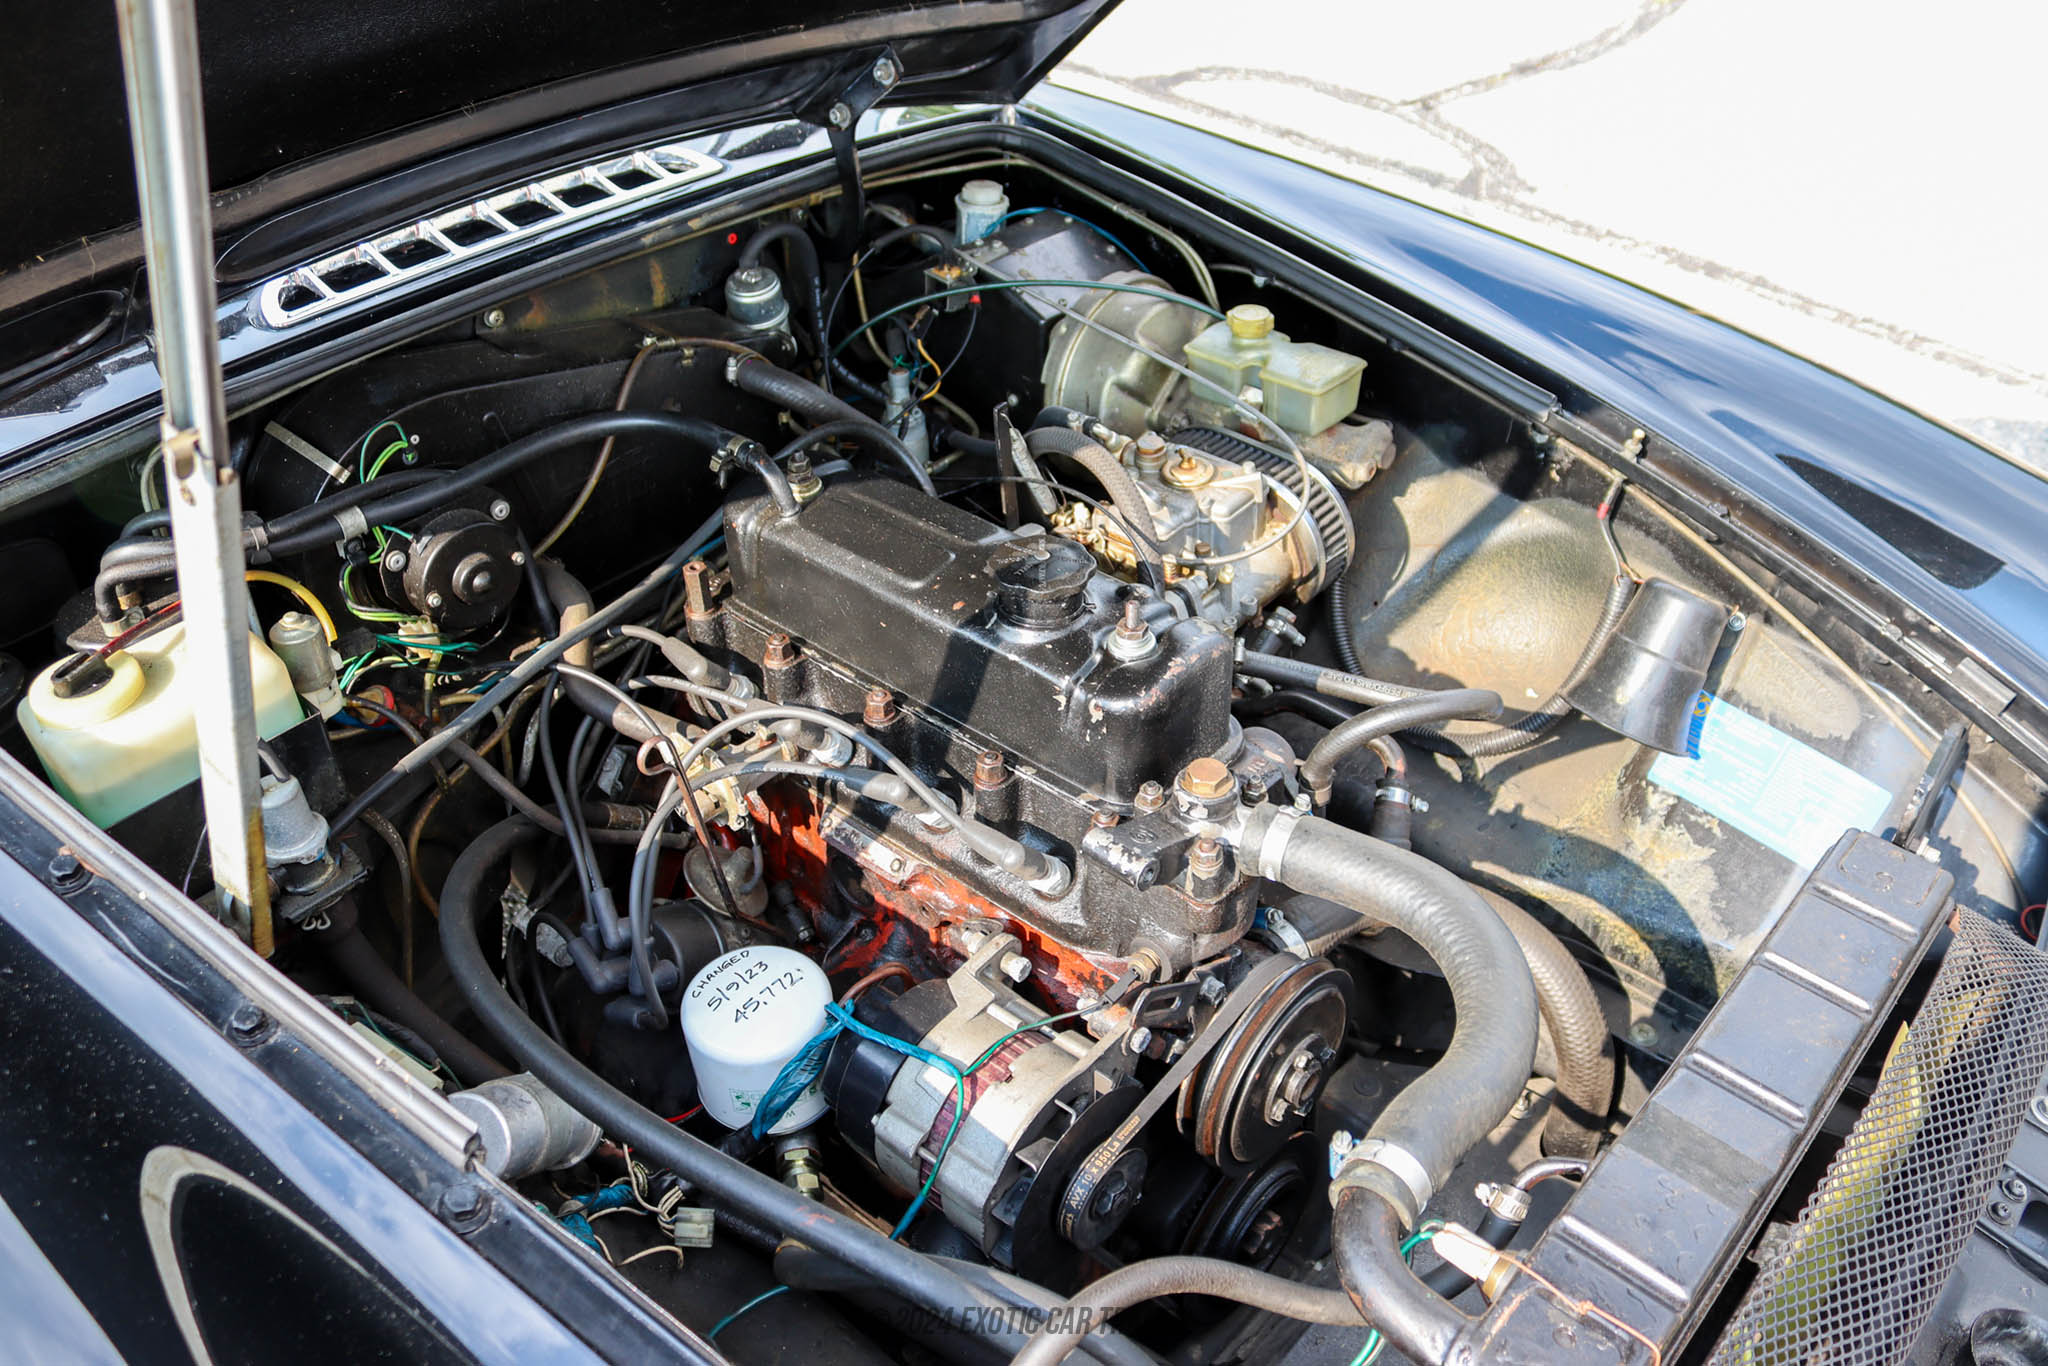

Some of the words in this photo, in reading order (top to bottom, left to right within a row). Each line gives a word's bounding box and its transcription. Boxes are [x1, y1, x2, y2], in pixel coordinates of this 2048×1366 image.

[692, 950, 750, 998] CHANGED
[707, 961, 769, 1012] 5/9/23
[1070, 1186, 1085, 1209] AVX
[1082, 1174, 1093, 1185] 10
[1096, 1151, 1111, 1168] 950
